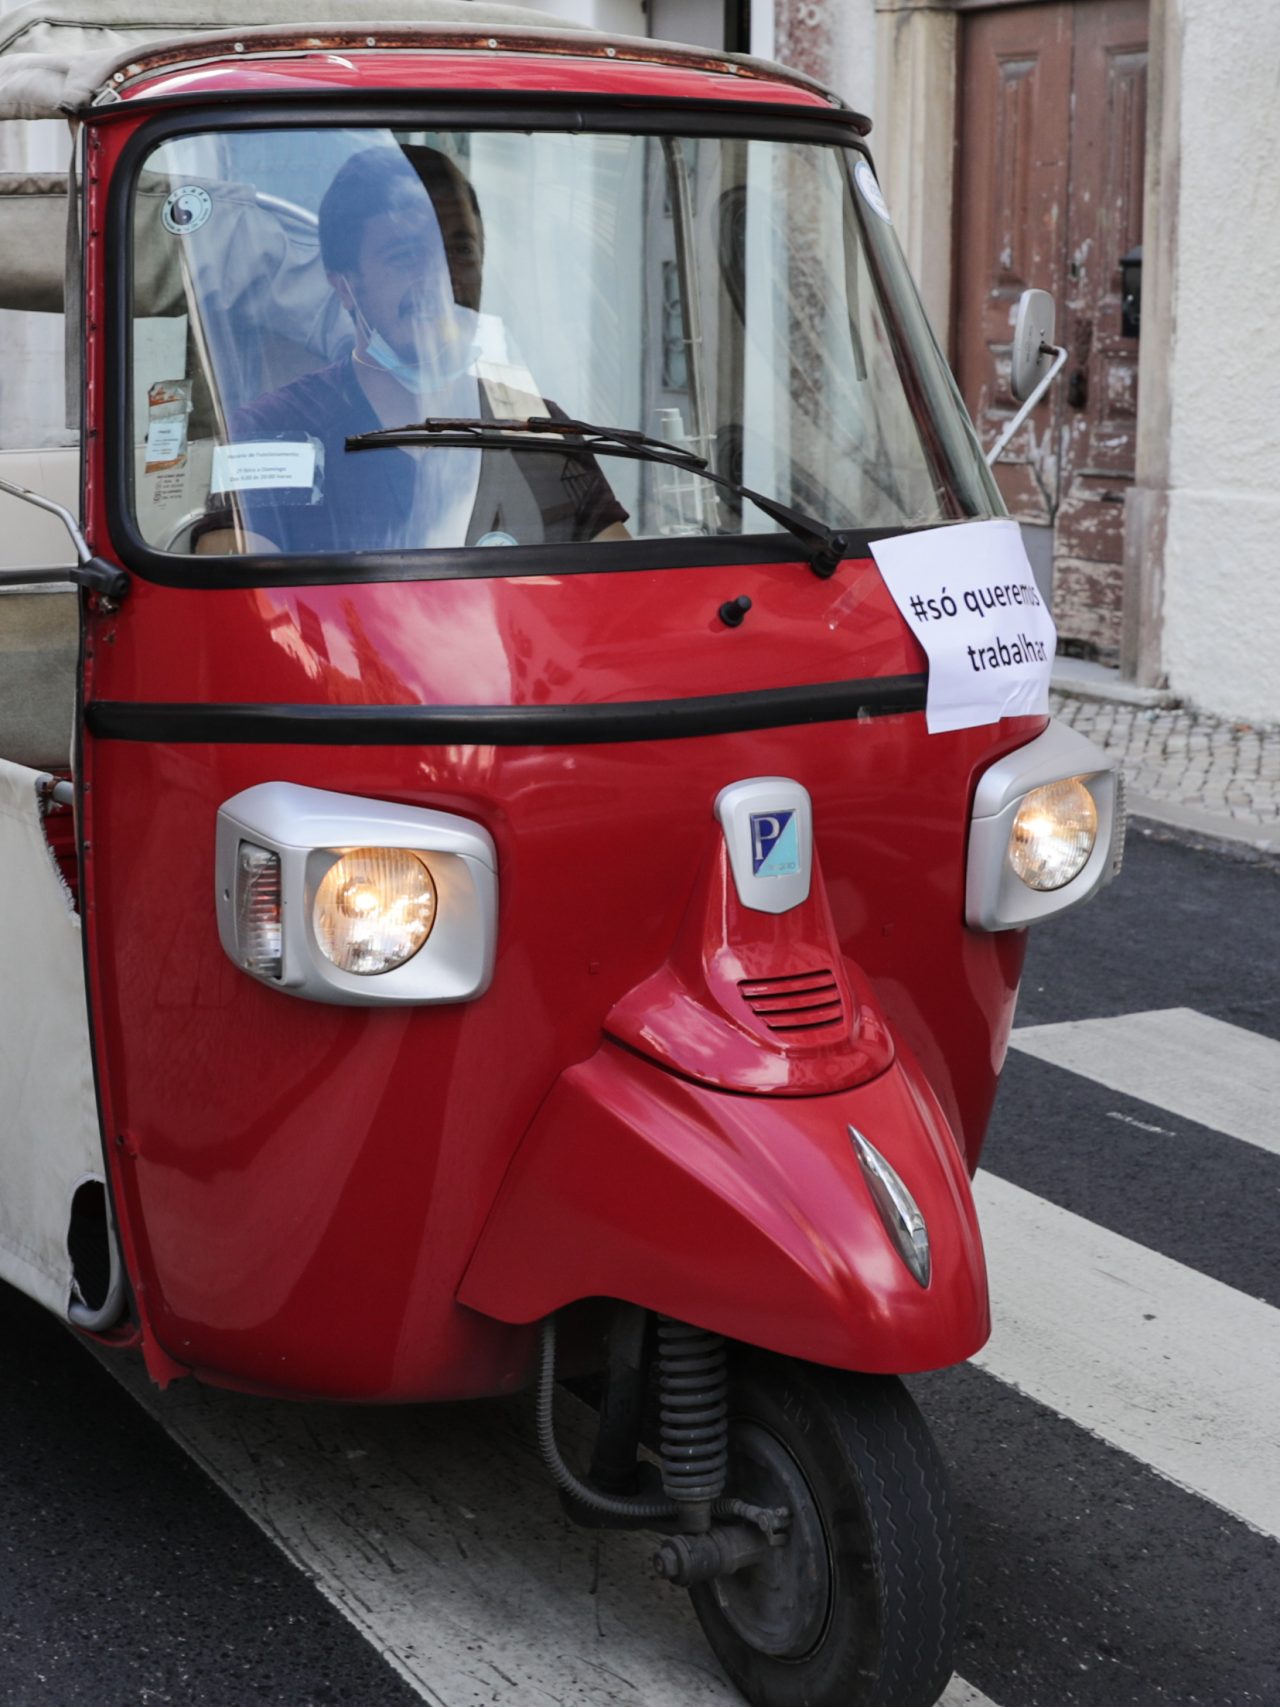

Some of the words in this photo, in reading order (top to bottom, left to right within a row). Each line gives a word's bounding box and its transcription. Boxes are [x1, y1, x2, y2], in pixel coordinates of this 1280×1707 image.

[910, 586, 957, 622] #só
[963, 583, 1041, 618] queremos
[968, 633, 1048, 672] trabalhar
[752, 816, 780, 860] P
